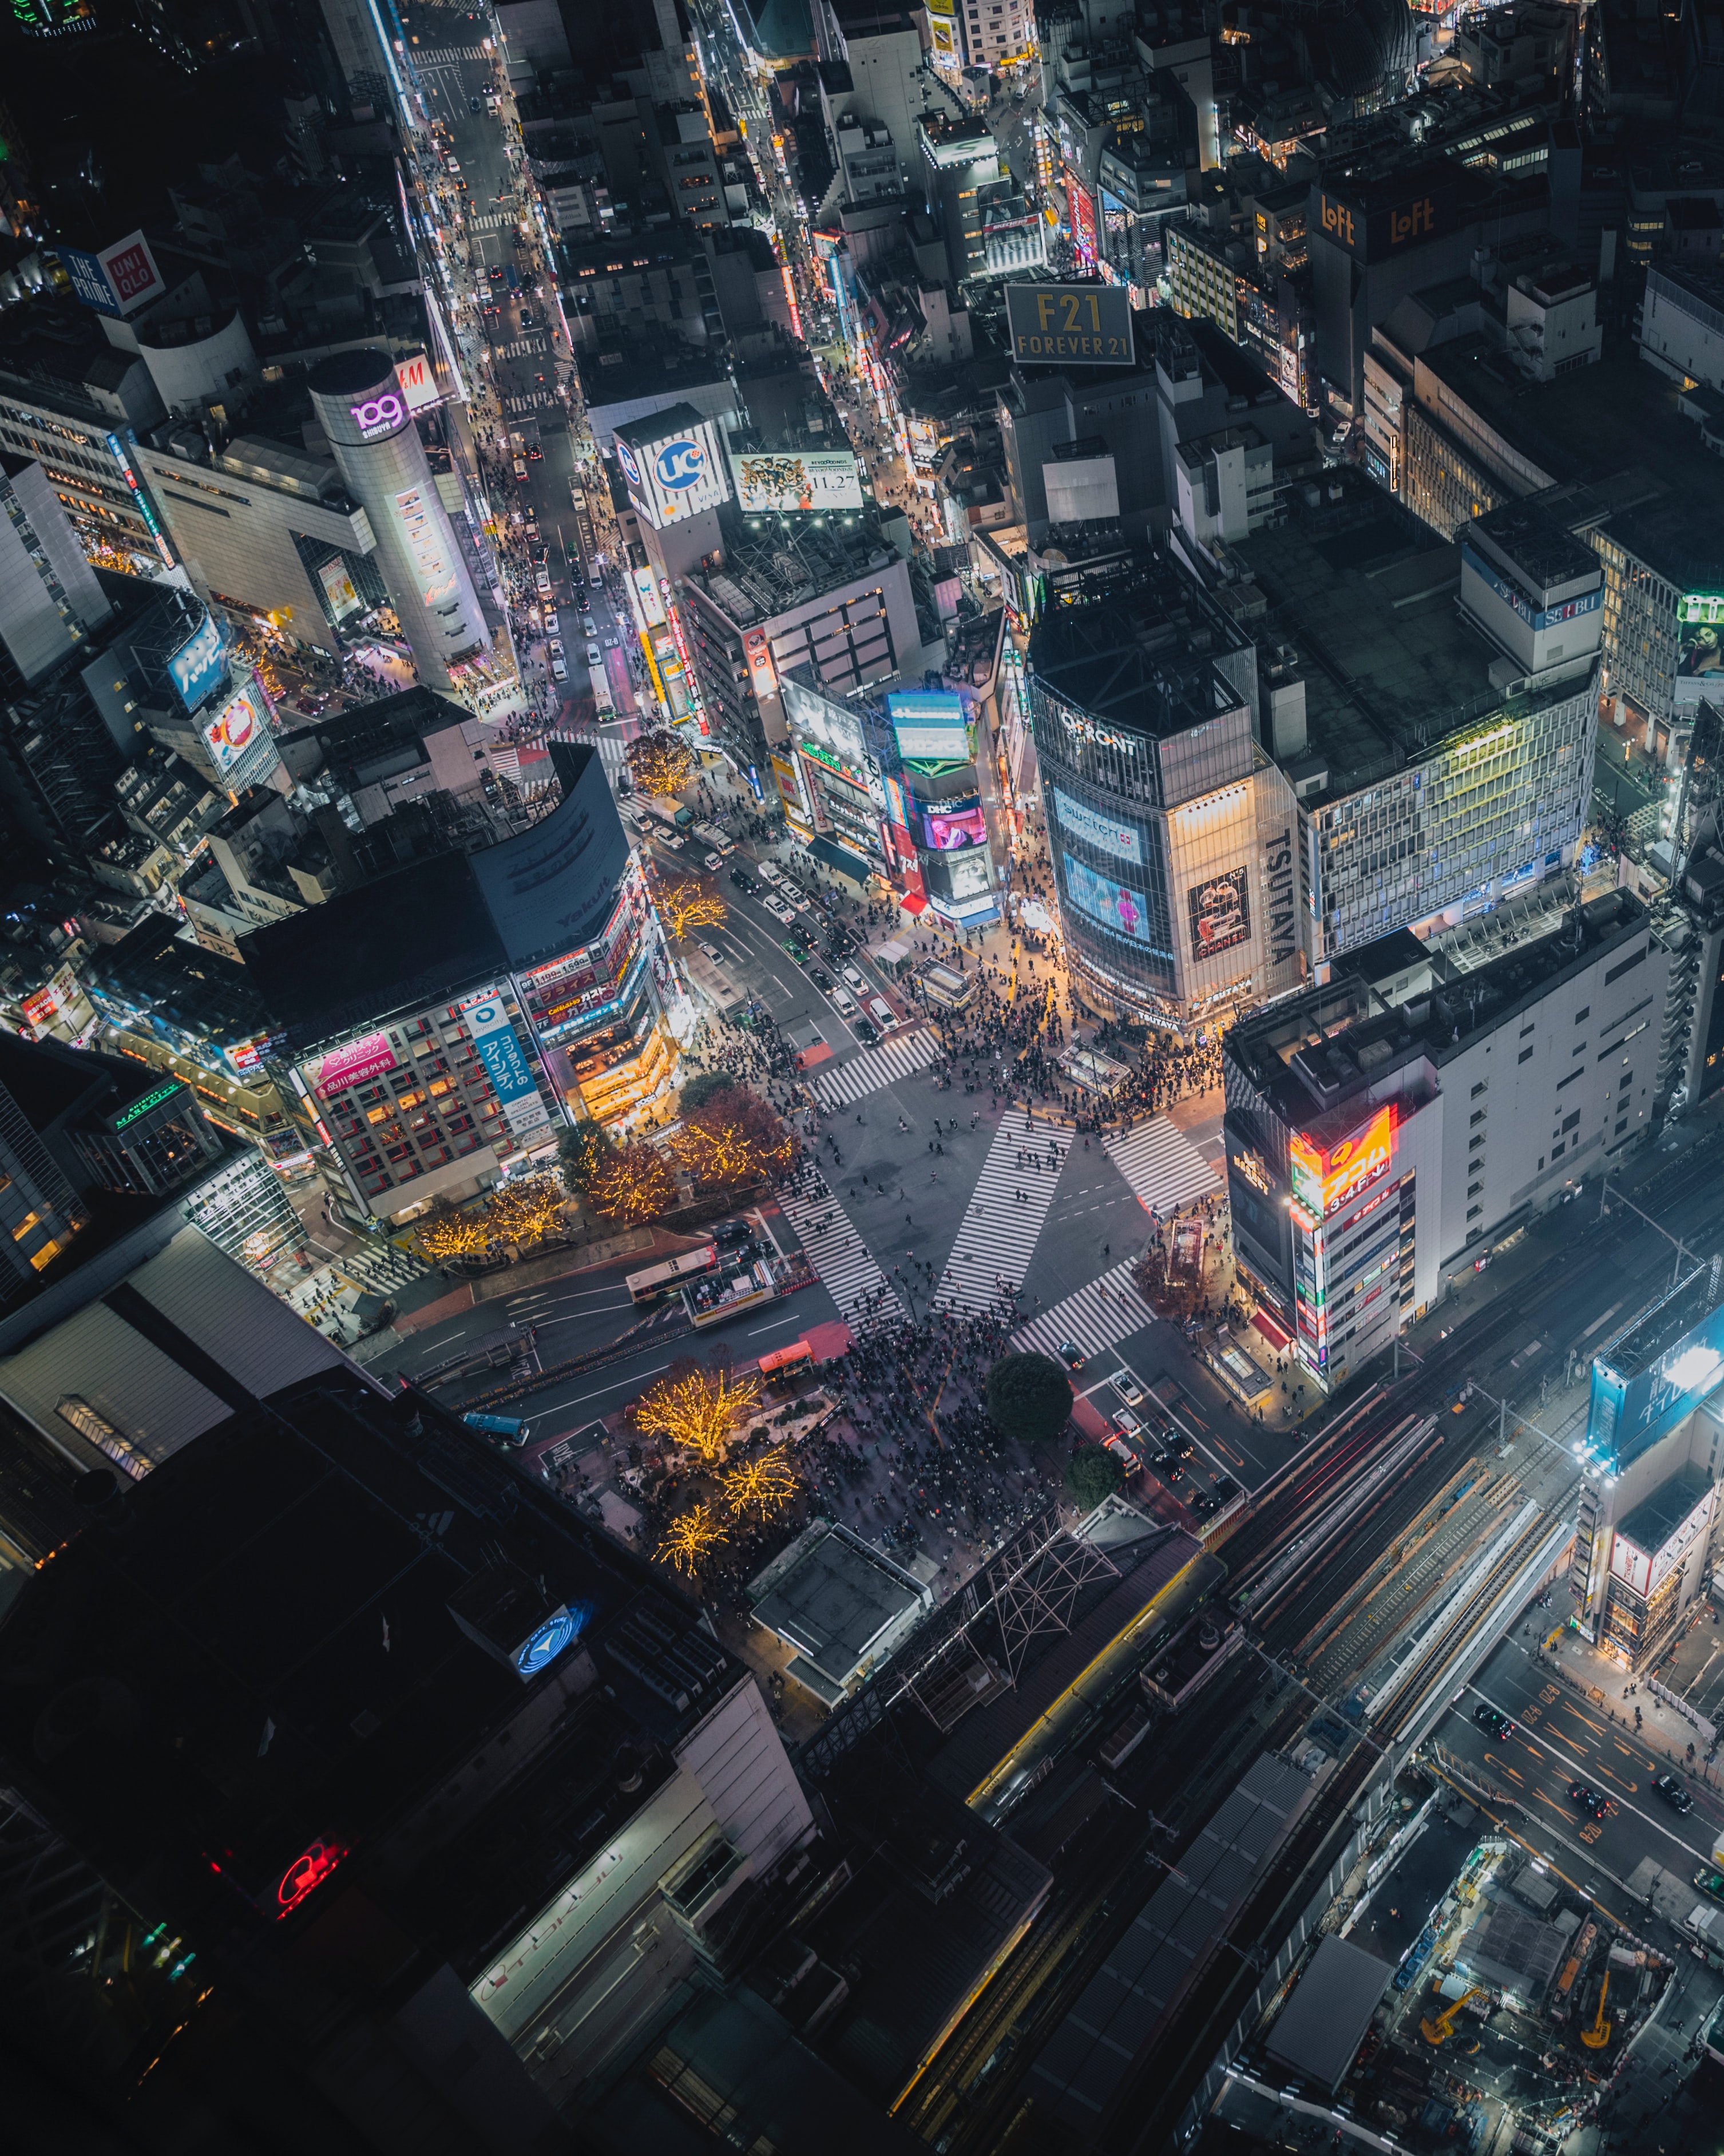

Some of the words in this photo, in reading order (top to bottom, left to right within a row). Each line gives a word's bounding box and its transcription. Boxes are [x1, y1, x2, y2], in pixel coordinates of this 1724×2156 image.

[993, 219, 1028, 230] SKECHERS
[69, 255, 97, 281] THE
[113, 252, 141, 277] UNI
[72, 276, 115, 306] PRIME
[120, 268, 149, 294] QLO
[1037, 294, 1101, 332] F21
[1018, 336, 1104, 355] FOREVER
[1108, 338, 1127, 355] 21
[350, 395, 403, 429] 109
[362, 422, 391, 439] SHIBUYA
[658, 448, 703, 482] UC
[813, 476, 854, 489] 11.27
[156, 537, 175, 568] HOOTERS
[1545, 596, 1595, 626] SEIBU
[1061, 712, 1136, 755] QFRONT
[927, 805, 952, 814] DHC
[555, 876, 611, 928] Yakult
[1265, 828, 1296, 966] TSUTAYA
[1199, 932, 1246, 958] CHANEL
[521, 979, 533, 989] 9F
[1206, 978, 1252, 1003] TSUTAYA
[27, 996, 54, 1017] ESPACE
[475, 1018, 504, 1033] eyecity
[537, 1019, 549, 1030] 7F
[1138, 1010, 1179, 1031] TSUTAYA
[340, 1037, 381, 1059] 品川スキン
[343, 1045, 380, 1066] クリニック
[500, 1035, 528, 1086] コンタクトの
[327, 1058, 392, 1092] 品川美容外科
[482, 1041, 514, 1090] アイシティ
[114, 1102, 148, 1127] MARK
[147, 1082, 177, 1105] CITY
[1327, 1146, 1386, 1201] アコム
[1362, 1189, 1390, 1215] アイフル
